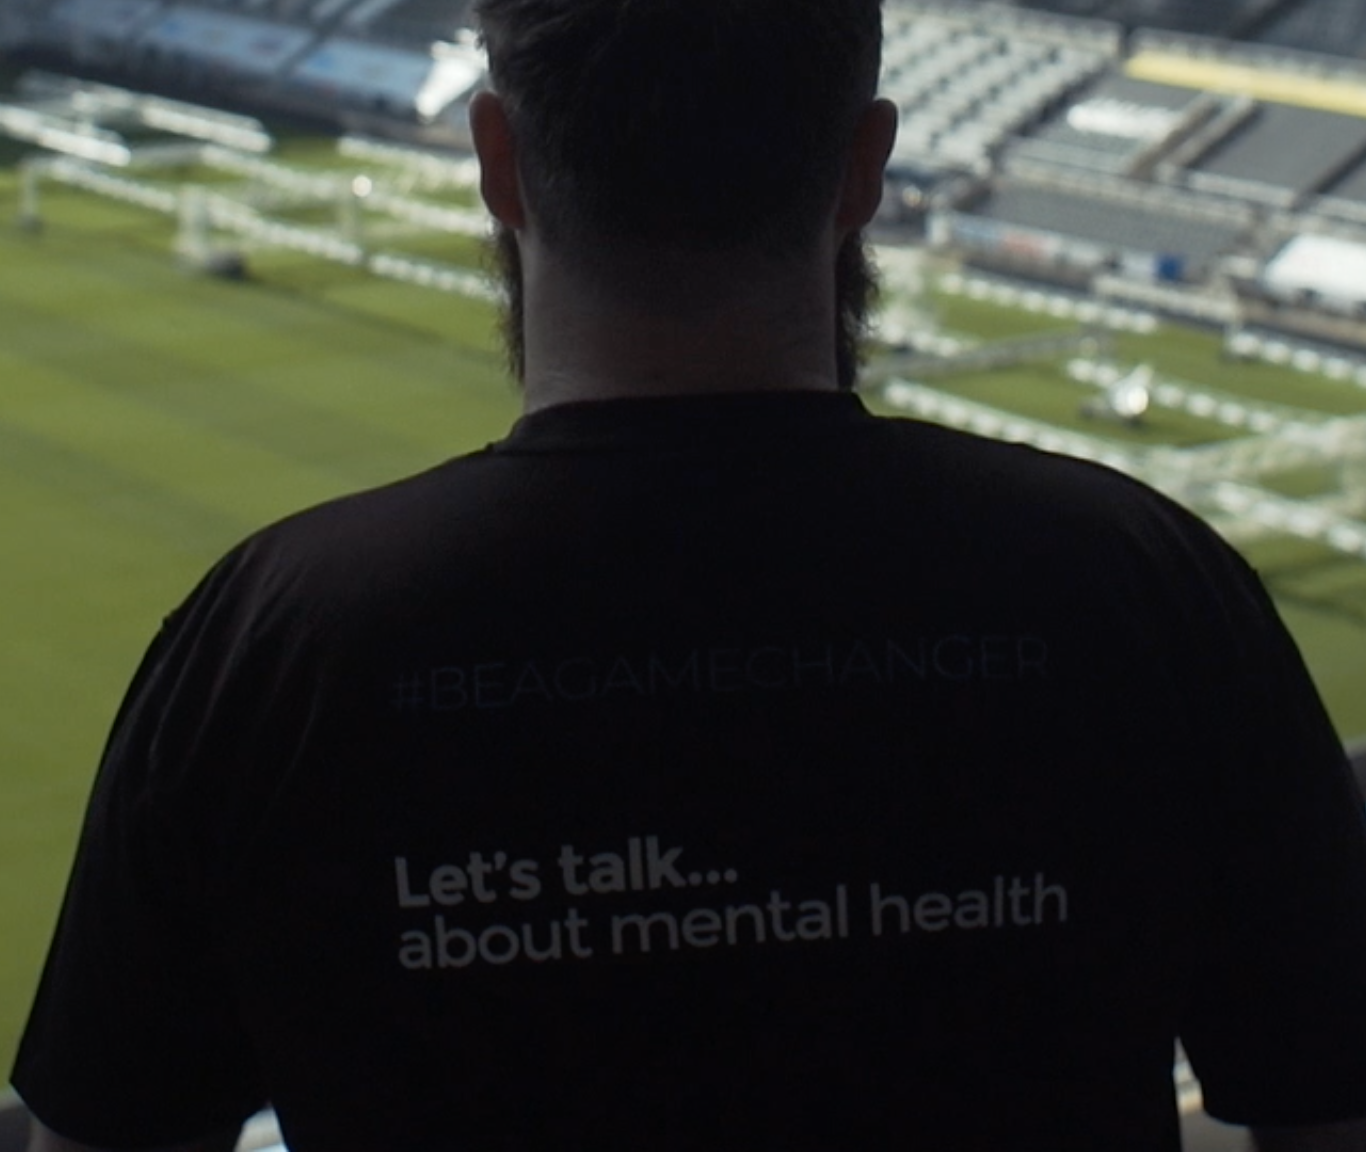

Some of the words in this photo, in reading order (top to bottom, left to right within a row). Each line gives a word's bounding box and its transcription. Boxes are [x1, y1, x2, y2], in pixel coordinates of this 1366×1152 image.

[389, 632, 1051, 713] #BEAGAMECHANGER
[393, 850, 542, 908] Let's
[557, 834, 738, 895] talk...
[398, 908, 593, 969] about
[611, 884, 848, 954] mental
[870, 872, 1068, 936] health
